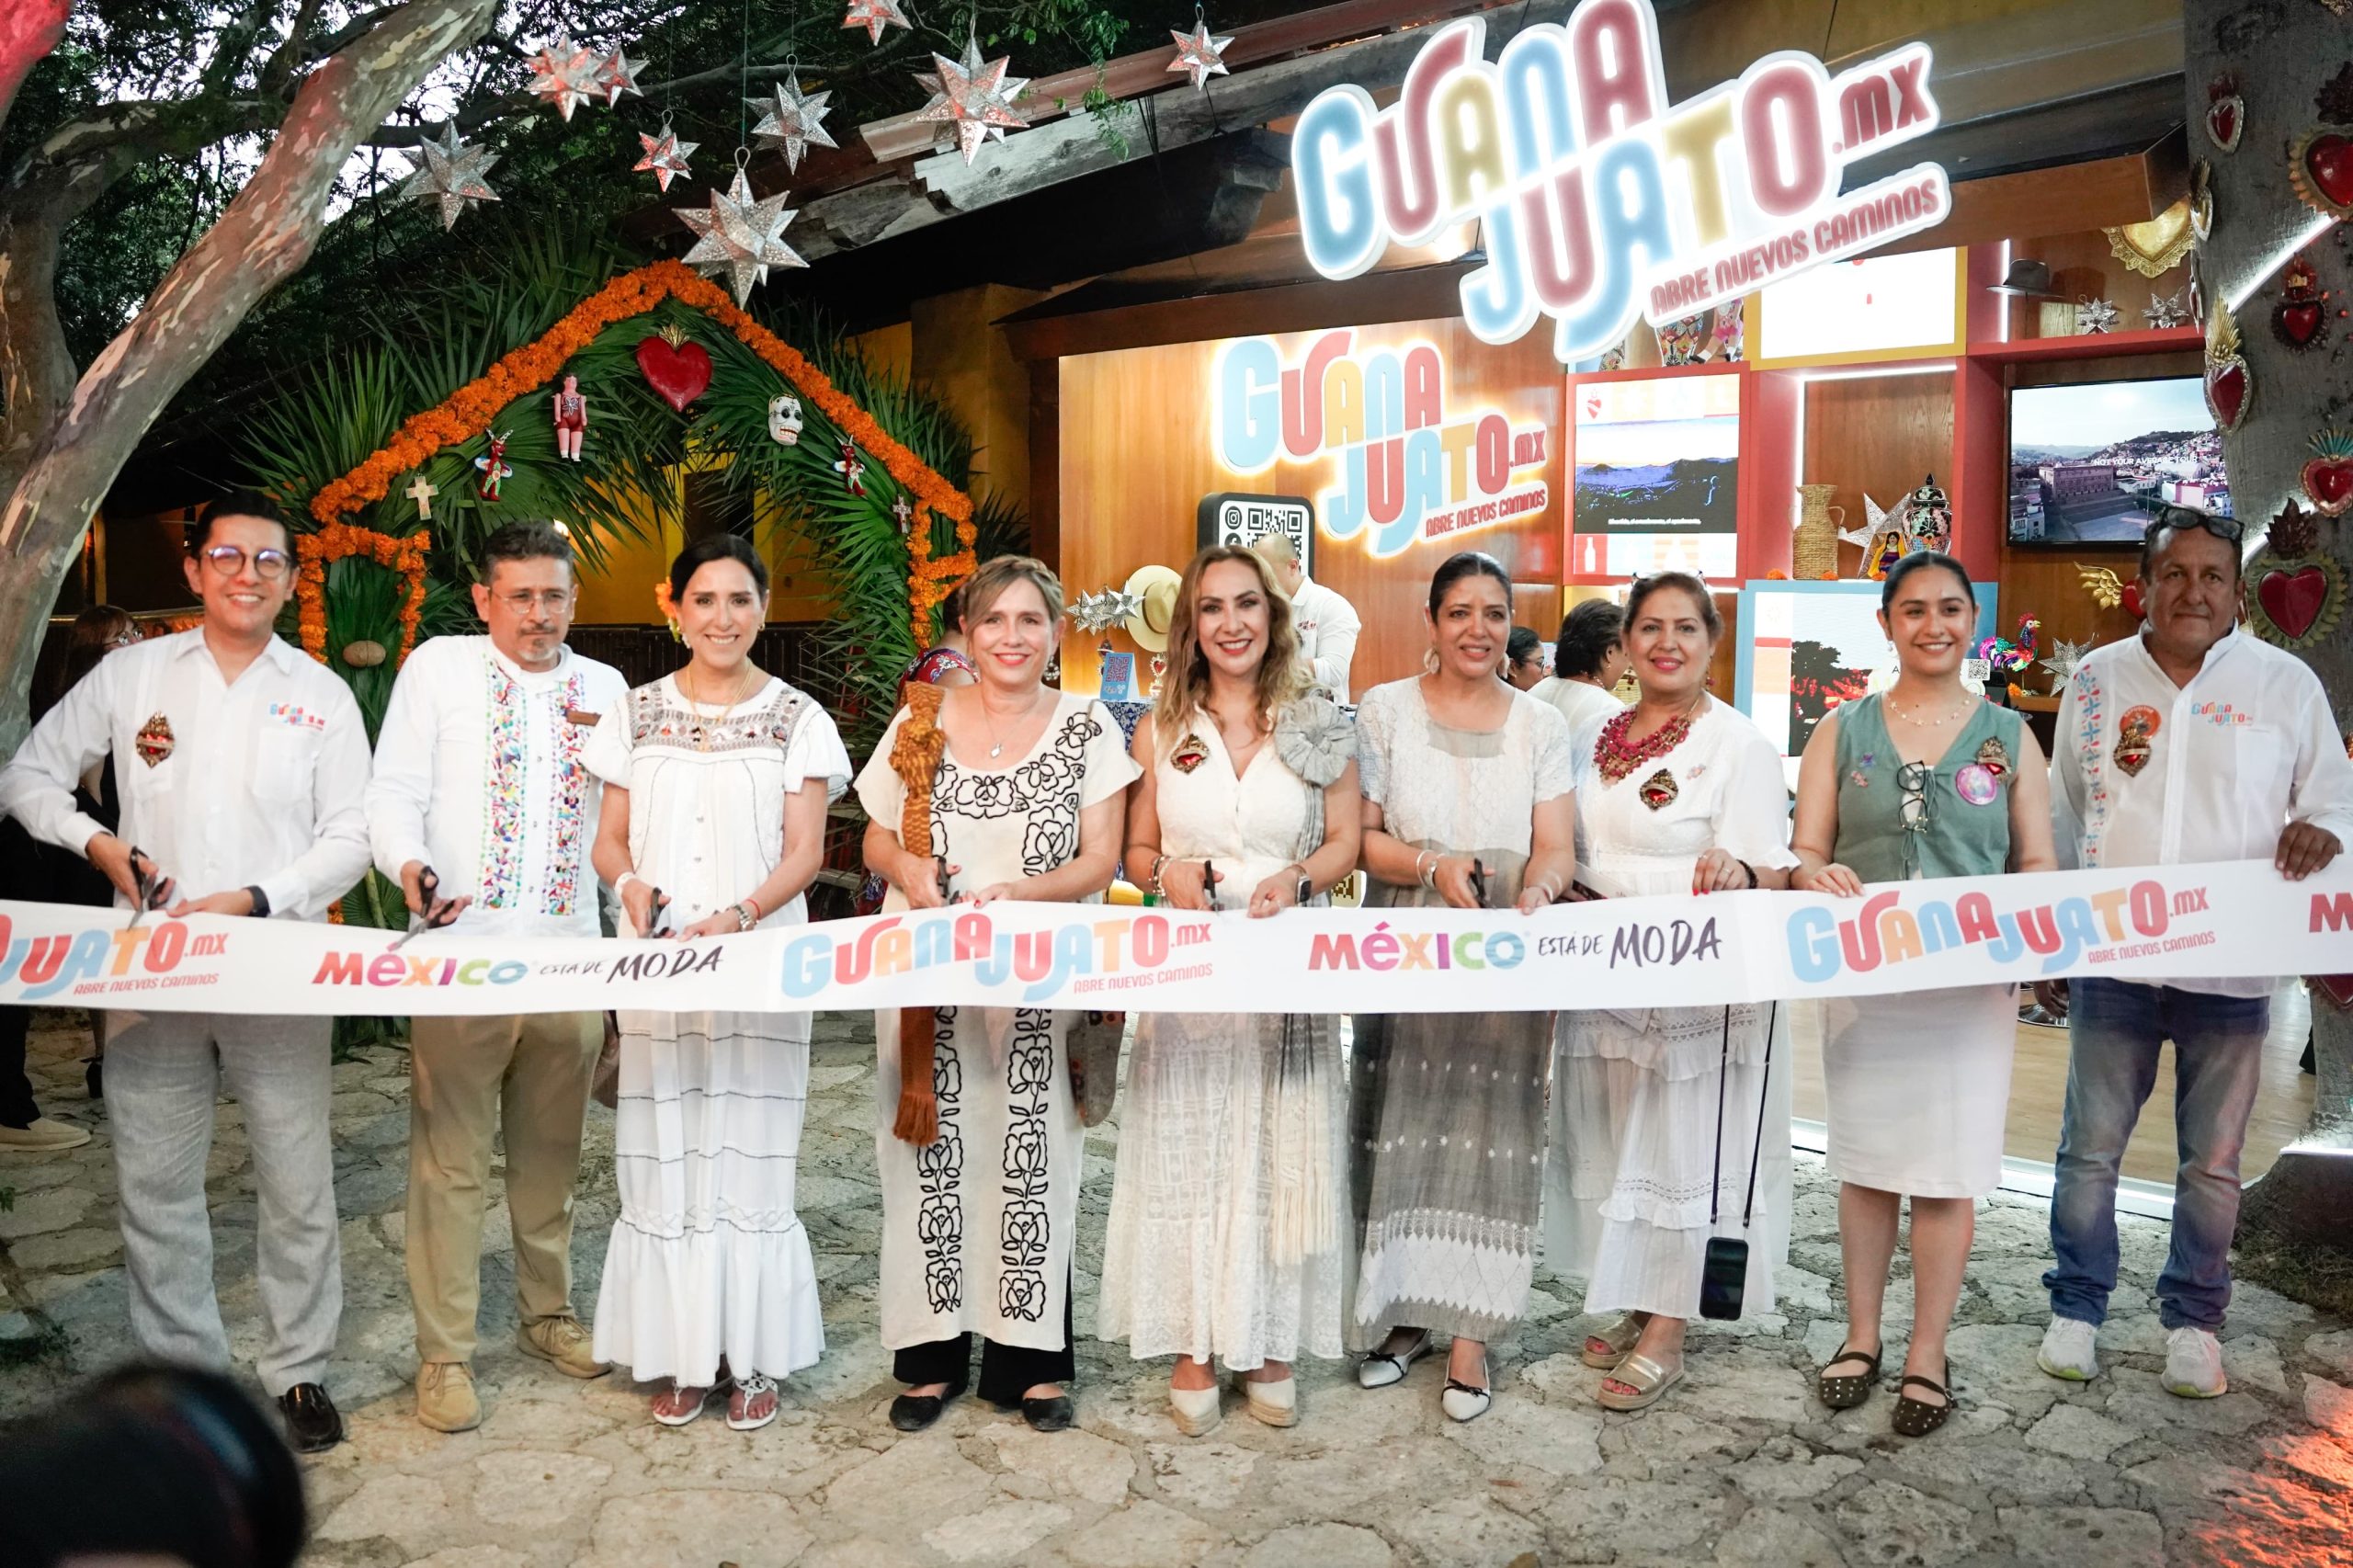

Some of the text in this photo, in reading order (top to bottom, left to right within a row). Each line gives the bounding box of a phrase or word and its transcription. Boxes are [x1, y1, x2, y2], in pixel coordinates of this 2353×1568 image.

[1651, 179, 1939, 316] ABRE NUEVOS CAMINOS
[1426, 489, 1546, 538] ABRE NUEVOS CAMINOS
[1582, 935, 1604, 956] DE
[1609, 916, 1722, 969] MODA
[2088, 931, 2215, 965] ABRE NUEVOS CAMINOS
[606, 945, 724, 983] MODA
[1074, 963, 1213, 994] ABRE NUEVOS CAMINOS
[74, 972, 220, 995] ABRE NUEVOS CAMINOS
